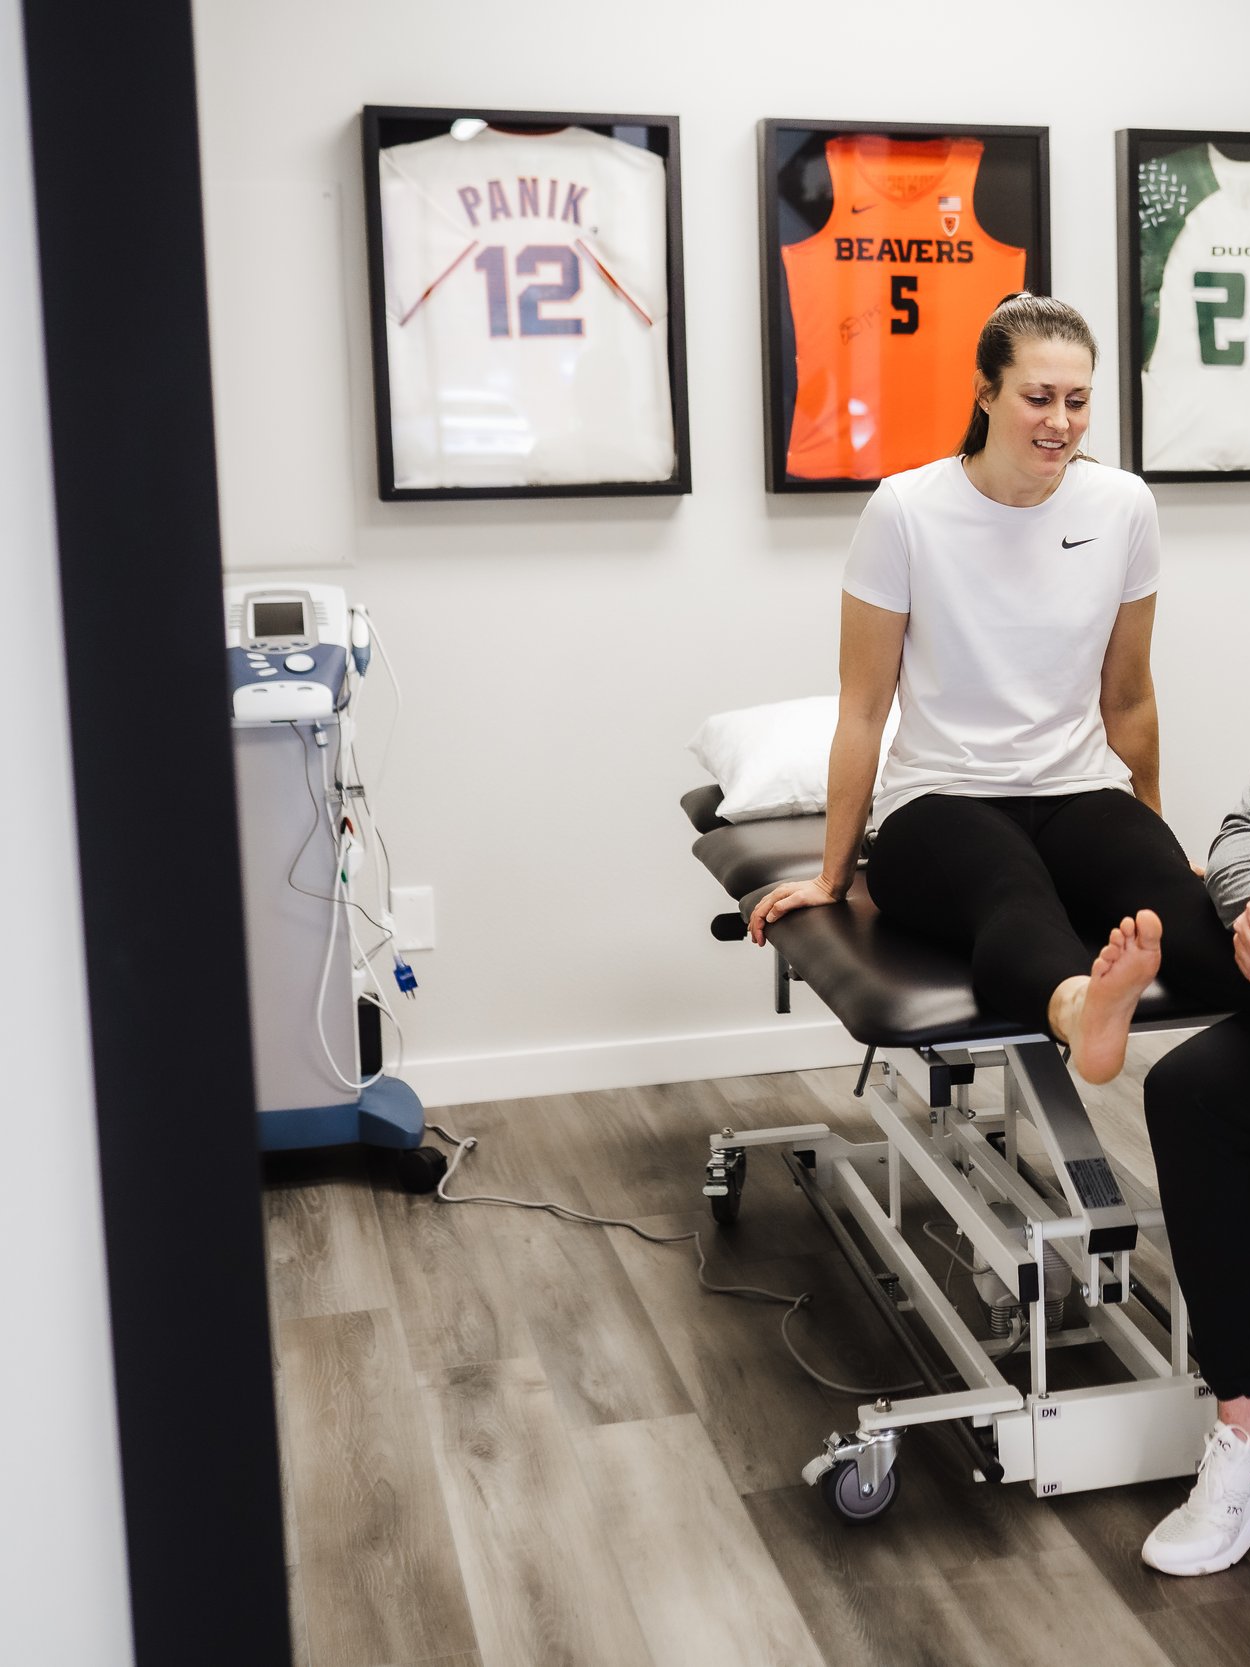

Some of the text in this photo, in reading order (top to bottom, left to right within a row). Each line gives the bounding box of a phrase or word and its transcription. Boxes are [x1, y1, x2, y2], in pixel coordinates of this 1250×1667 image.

[457, 176, 589, 228] PANIK
[834, 238, 974, 264] BEAVERS
[474, 244, 585, 338] 12
[891, 275, 919, 335] 5
[1198, 1387, 1213, 1397] DN
[1042, 1408, 1057, 1418] DN
[1043, 1484, 1058, 1495] UP
